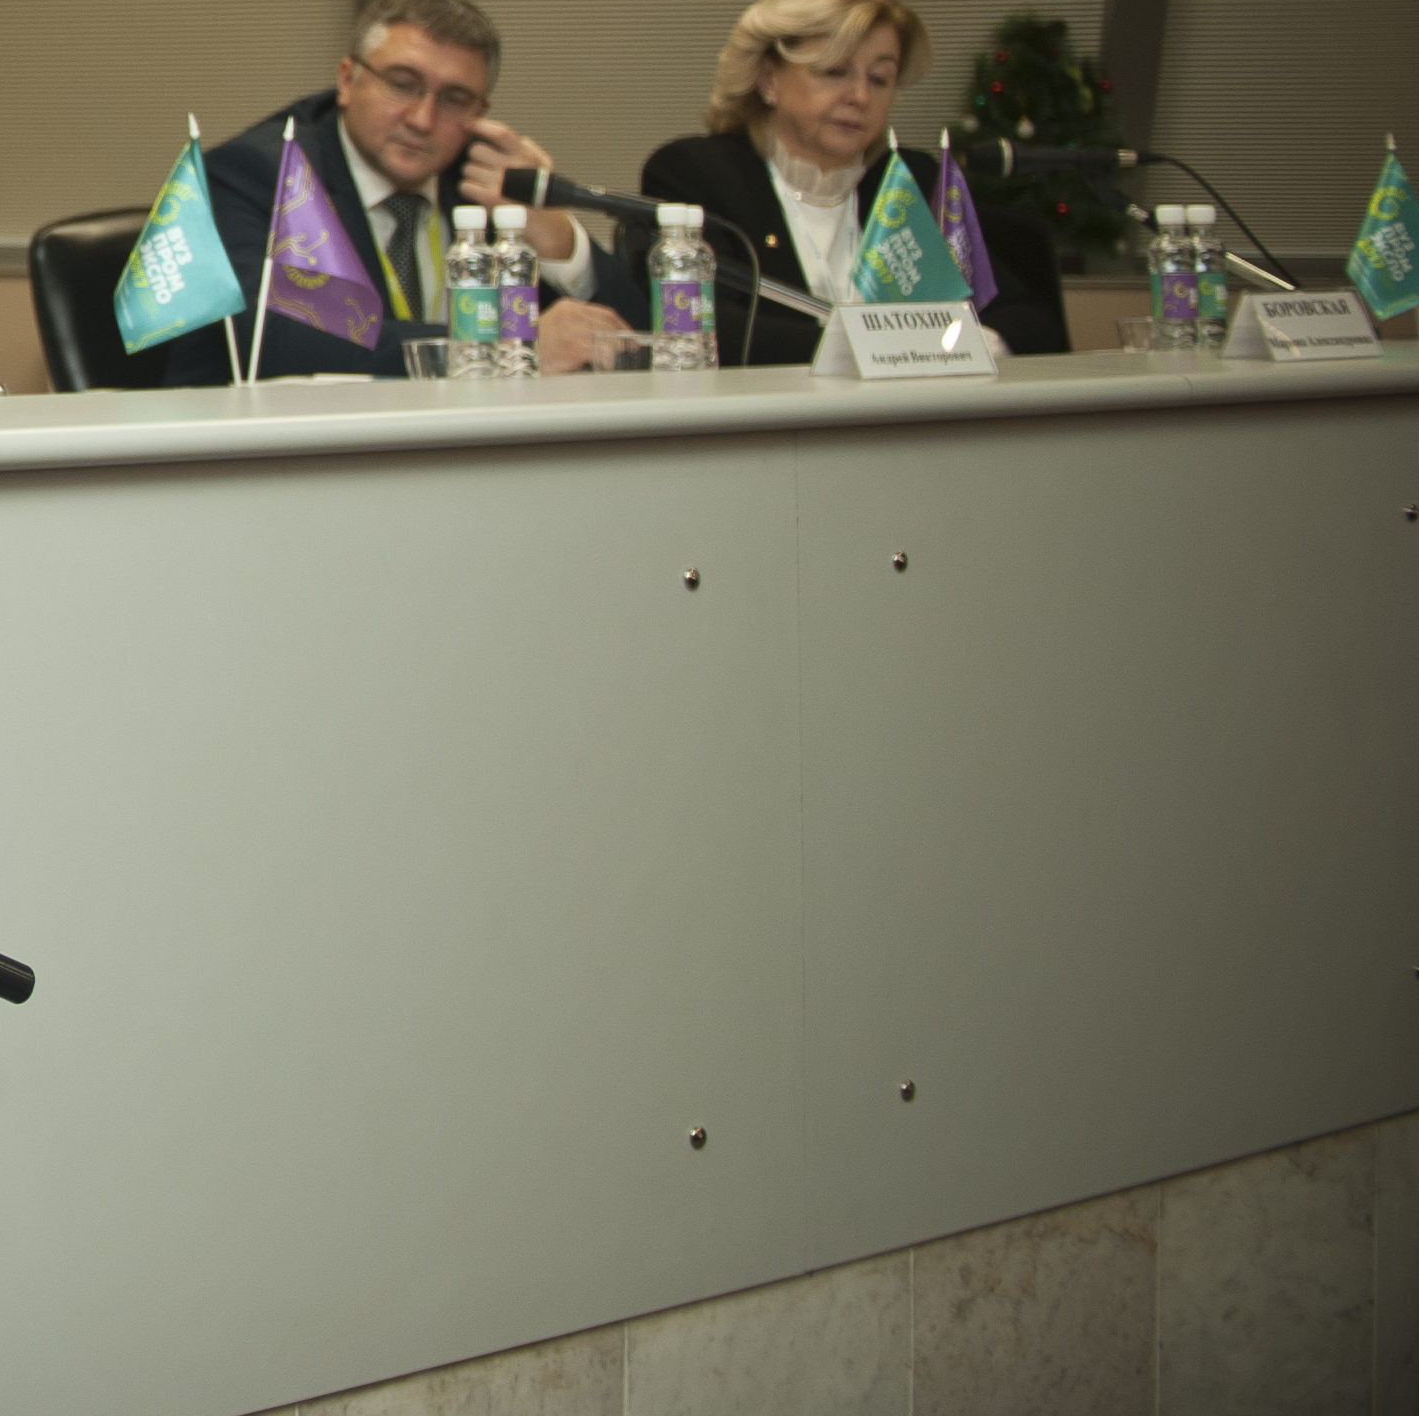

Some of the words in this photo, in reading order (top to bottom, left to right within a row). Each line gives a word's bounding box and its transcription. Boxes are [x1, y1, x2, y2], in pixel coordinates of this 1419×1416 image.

[152, 232, 185, 293] ПРОМ
[166, 226, 193, 265] ВУЗ
[140, 240, 172, 305] ЭКСПО
[862, 310, 954, 331] ШАТОХИН
[1263, 298, 1352, 317] БОРОВСКАЯ
